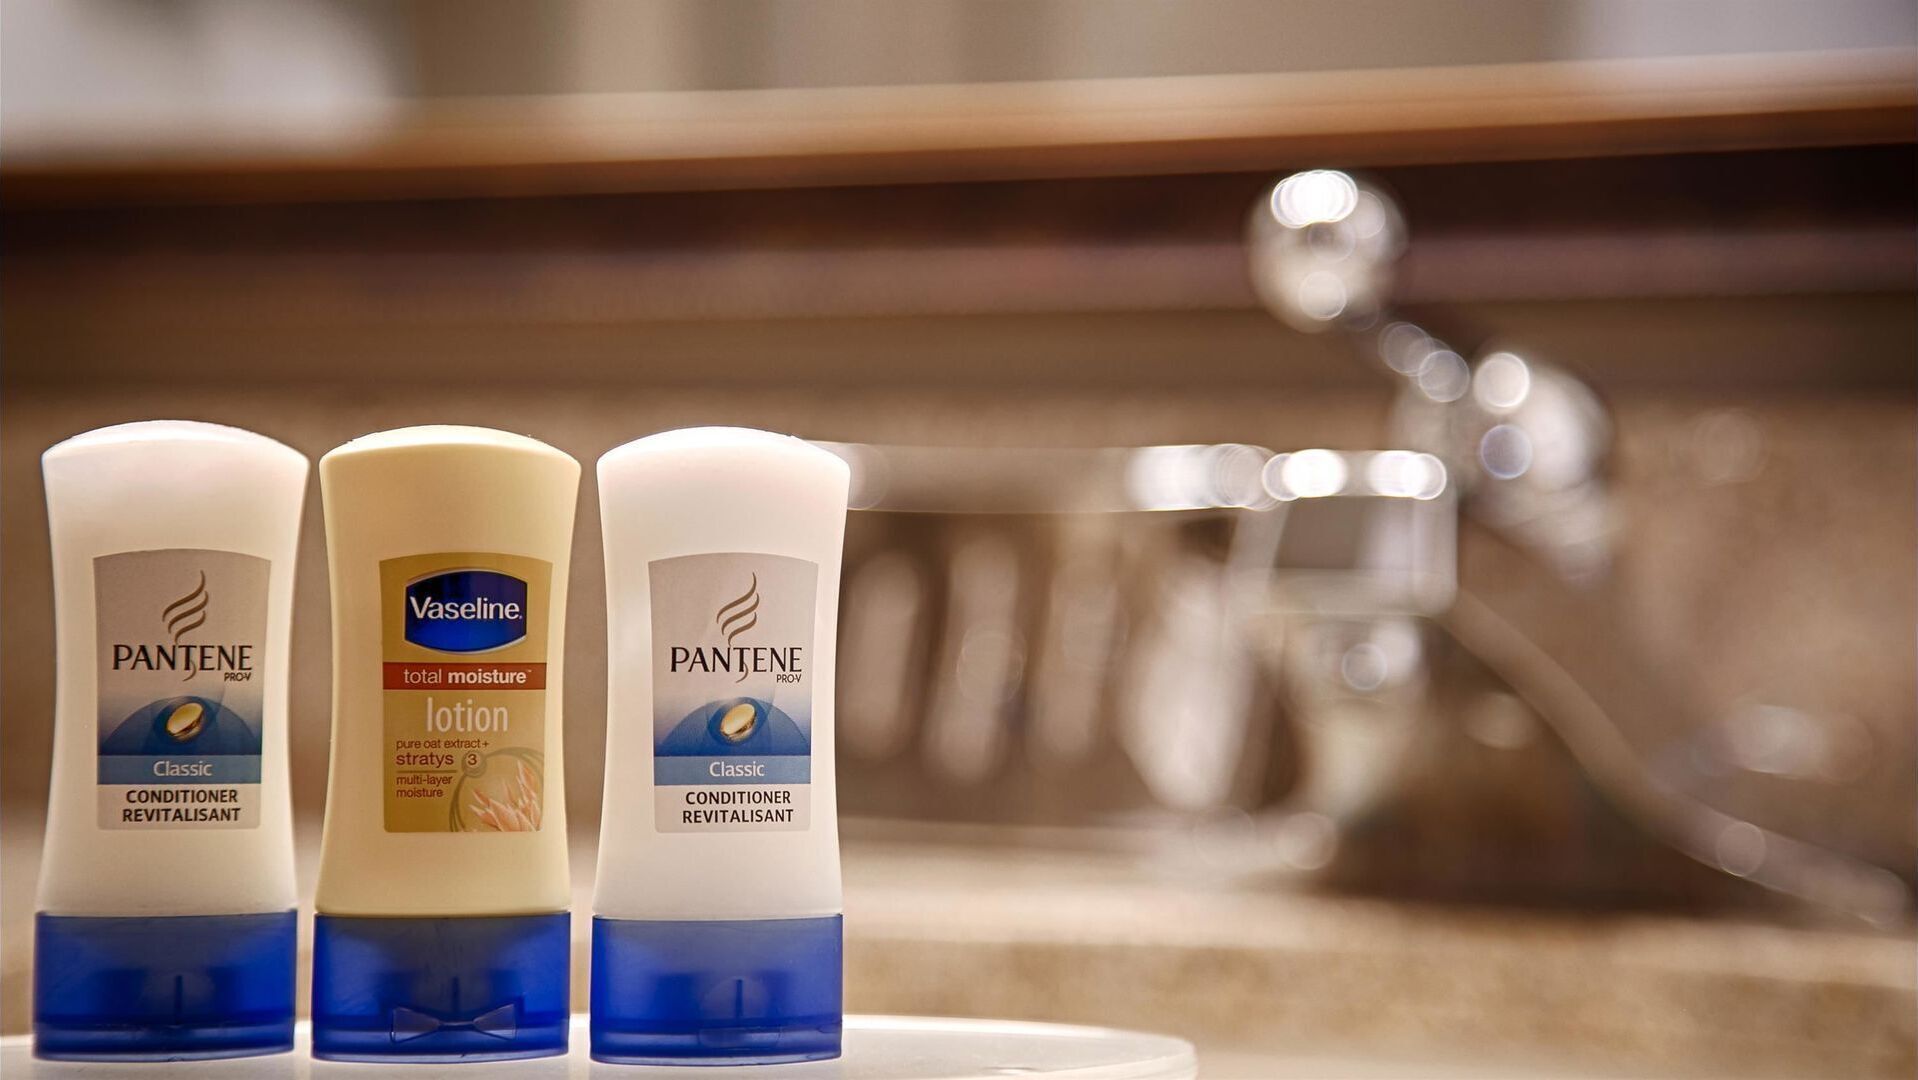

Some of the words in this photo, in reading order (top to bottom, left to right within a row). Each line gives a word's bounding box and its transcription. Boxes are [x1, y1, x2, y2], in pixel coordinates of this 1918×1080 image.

[112, 645, 253, 671] PANTENE
[670, 647, 803, 673] PANTENE
[404, 669, 442, 684] total
[776, 674, 802, 683] PRO-V
[427, 697, 509, 732] lotion
[396, 741, 421, 751] pure
[423, 739, 441, 749] oat
[396, 752, 454, 768] stratys
[467, 754, 478, 766] 3
[153, 760, 213, 777] Classic
[709, 761, 765, 777] Classic
[396, 774, 453, 787] multi-layer
[126, 789, 238, 804] CONDITIONER
[396, 787, 444, 798] moisture
[686, 791, 791, 805] CONDITIONER
[122, 808, 241, 823] REVITALISANT
[682, 809, 794, 824] REVITALISANT
